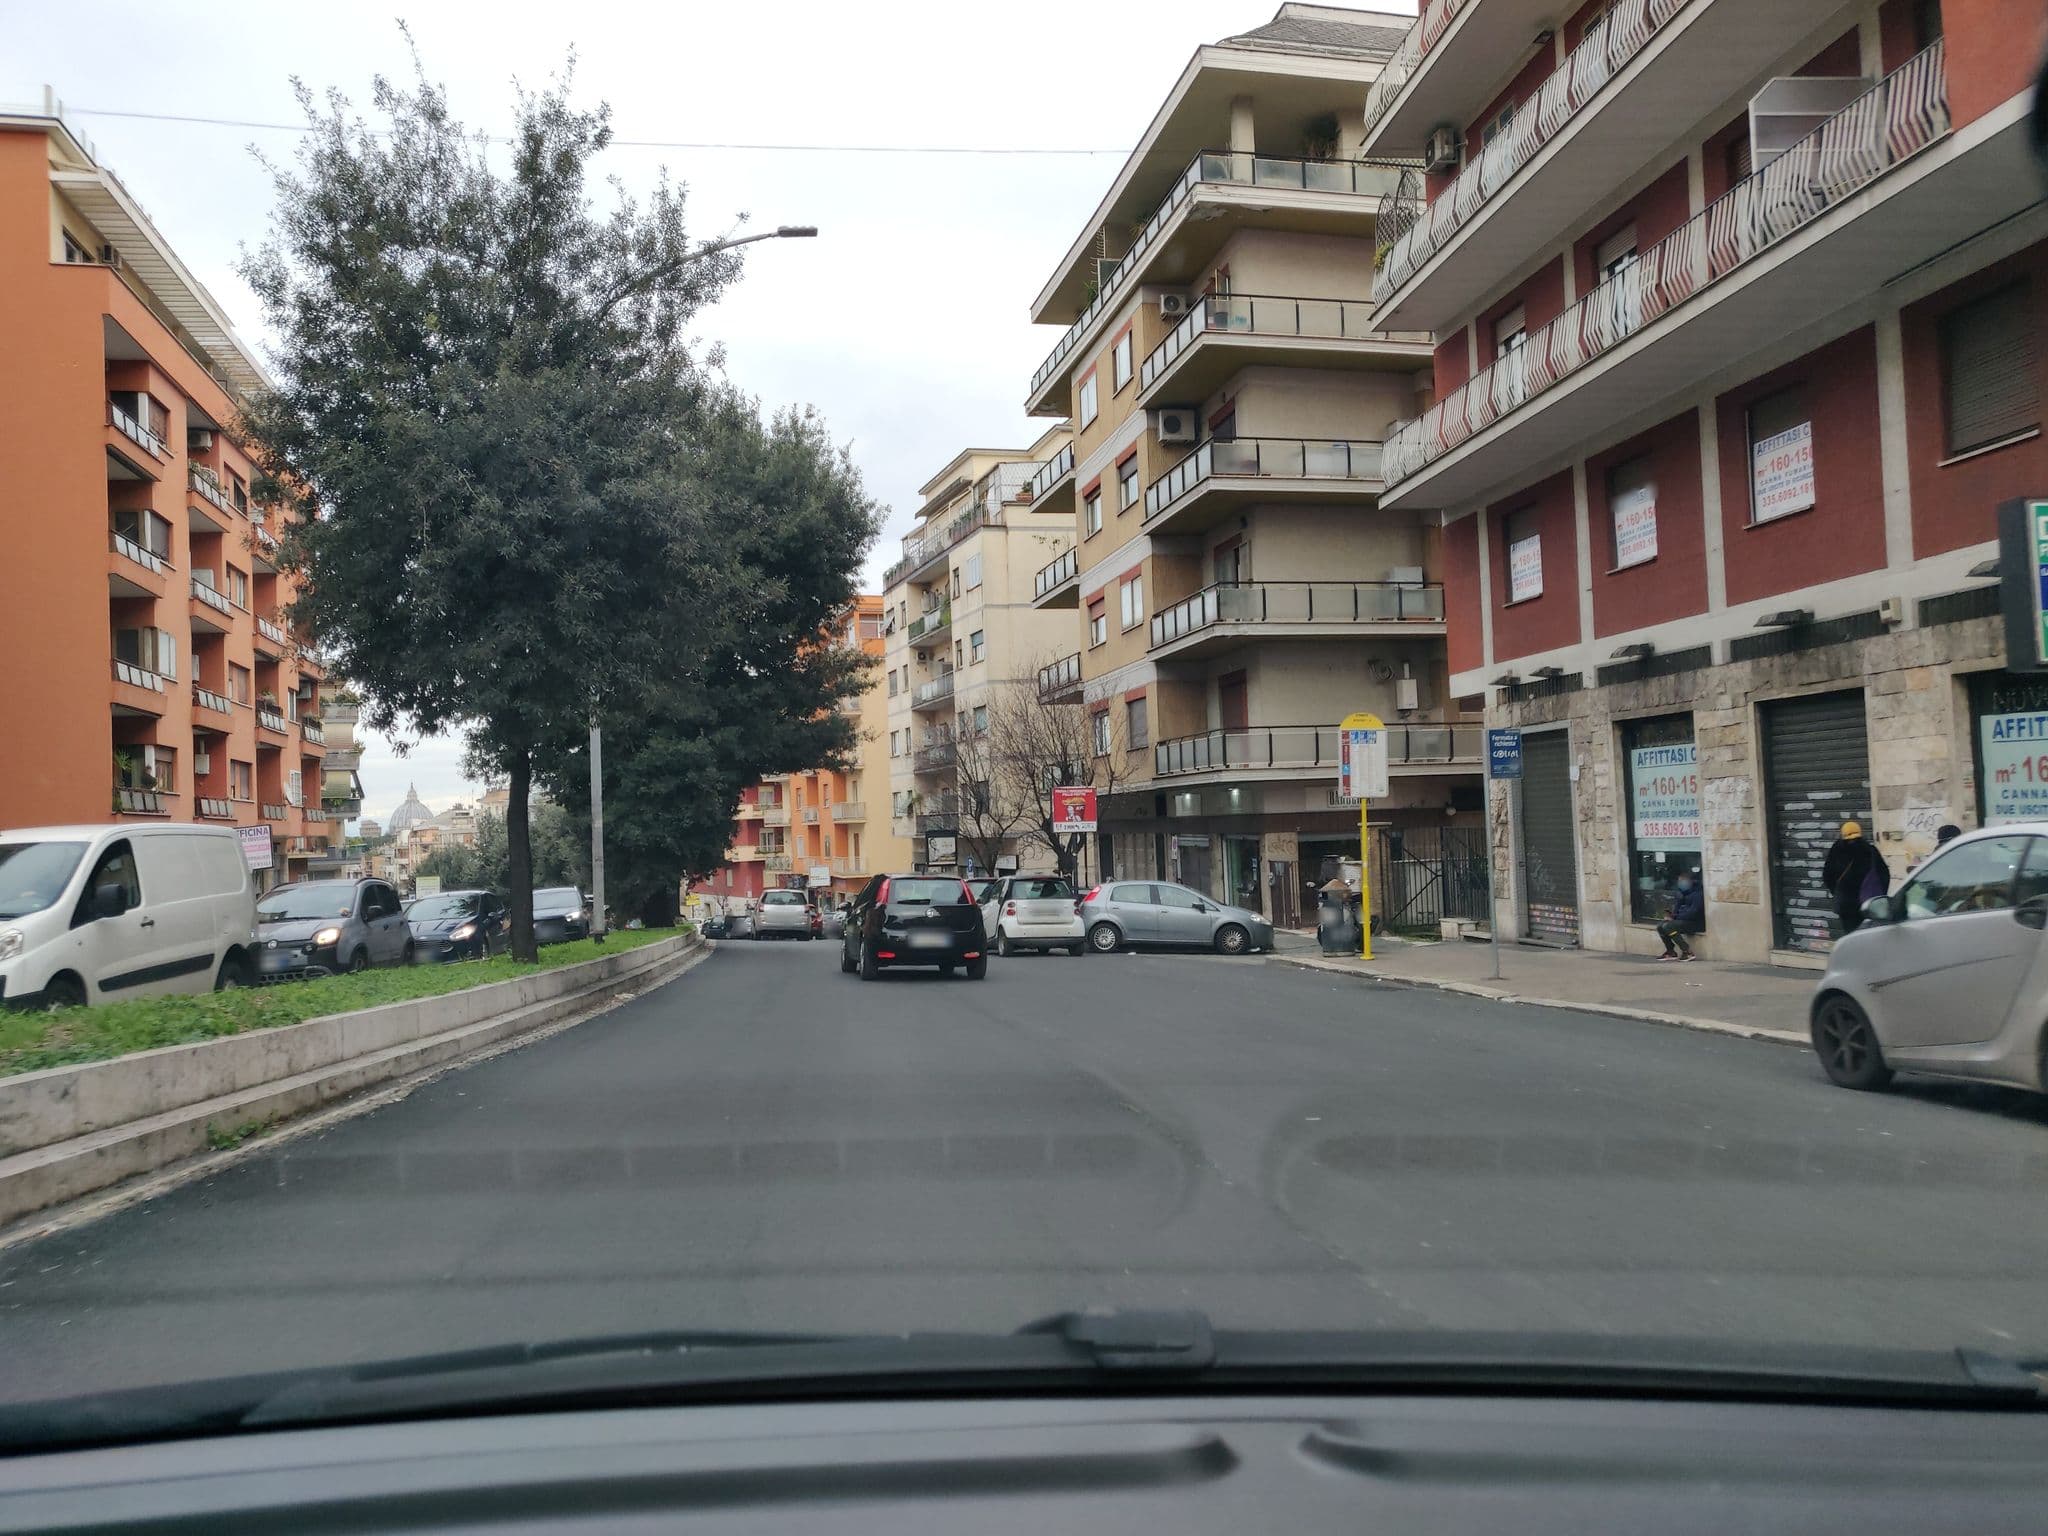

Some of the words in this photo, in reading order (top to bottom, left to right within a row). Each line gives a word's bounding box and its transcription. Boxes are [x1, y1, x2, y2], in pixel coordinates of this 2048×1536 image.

[1757, 429, 1801, 455] AFFITTASI
[1637, 749, 1687, 767] AFFITTASI
[1995, 763, 2017, 783] m²
[1642, 799, 1666, 808] CANNA
[1996, 804, 2016, 815] DUE
